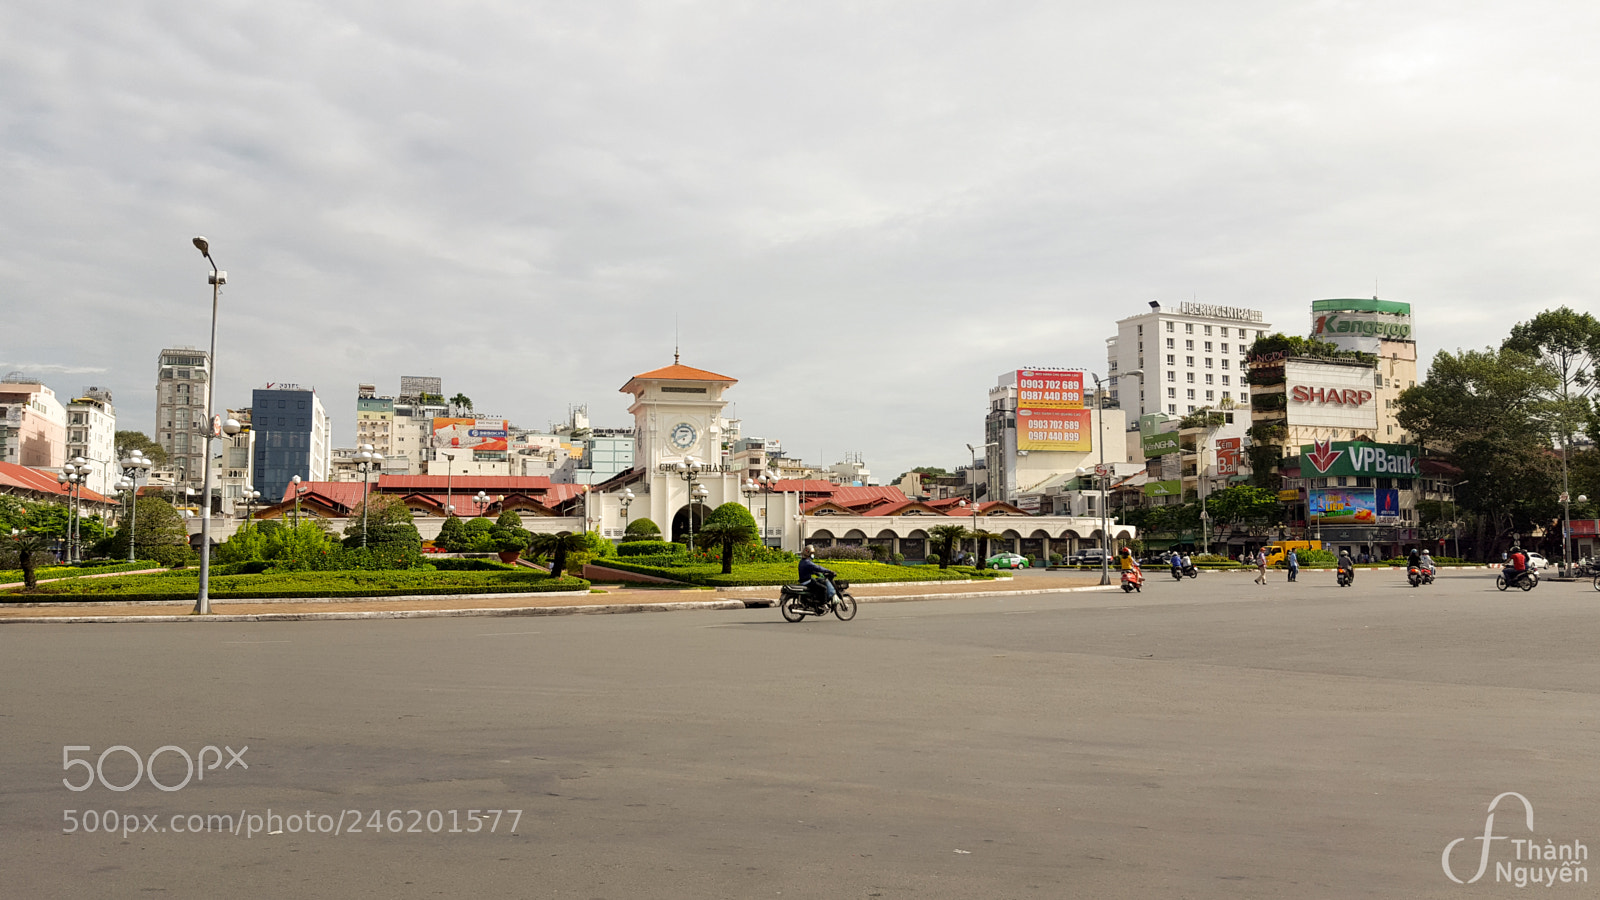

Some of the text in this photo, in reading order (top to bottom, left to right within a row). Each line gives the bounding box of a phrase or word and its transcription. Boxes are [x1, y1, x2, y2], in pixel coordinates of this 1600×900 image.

[1020, 379, 1080, 390] 0903 702 689
[1020, 391, 1079, 401] 0987 440 899
[1292, 385, 1372, 406] SHARP
[1028, 420, 1080, 430] 0903 702 689
[1028, 431, 1080, 442] 0987 440 899
[1217, 456, 1237, 473] Ball
[1348, 446, 1417, 475] VPBank
[701, 462, 731, 472] THÀNH
